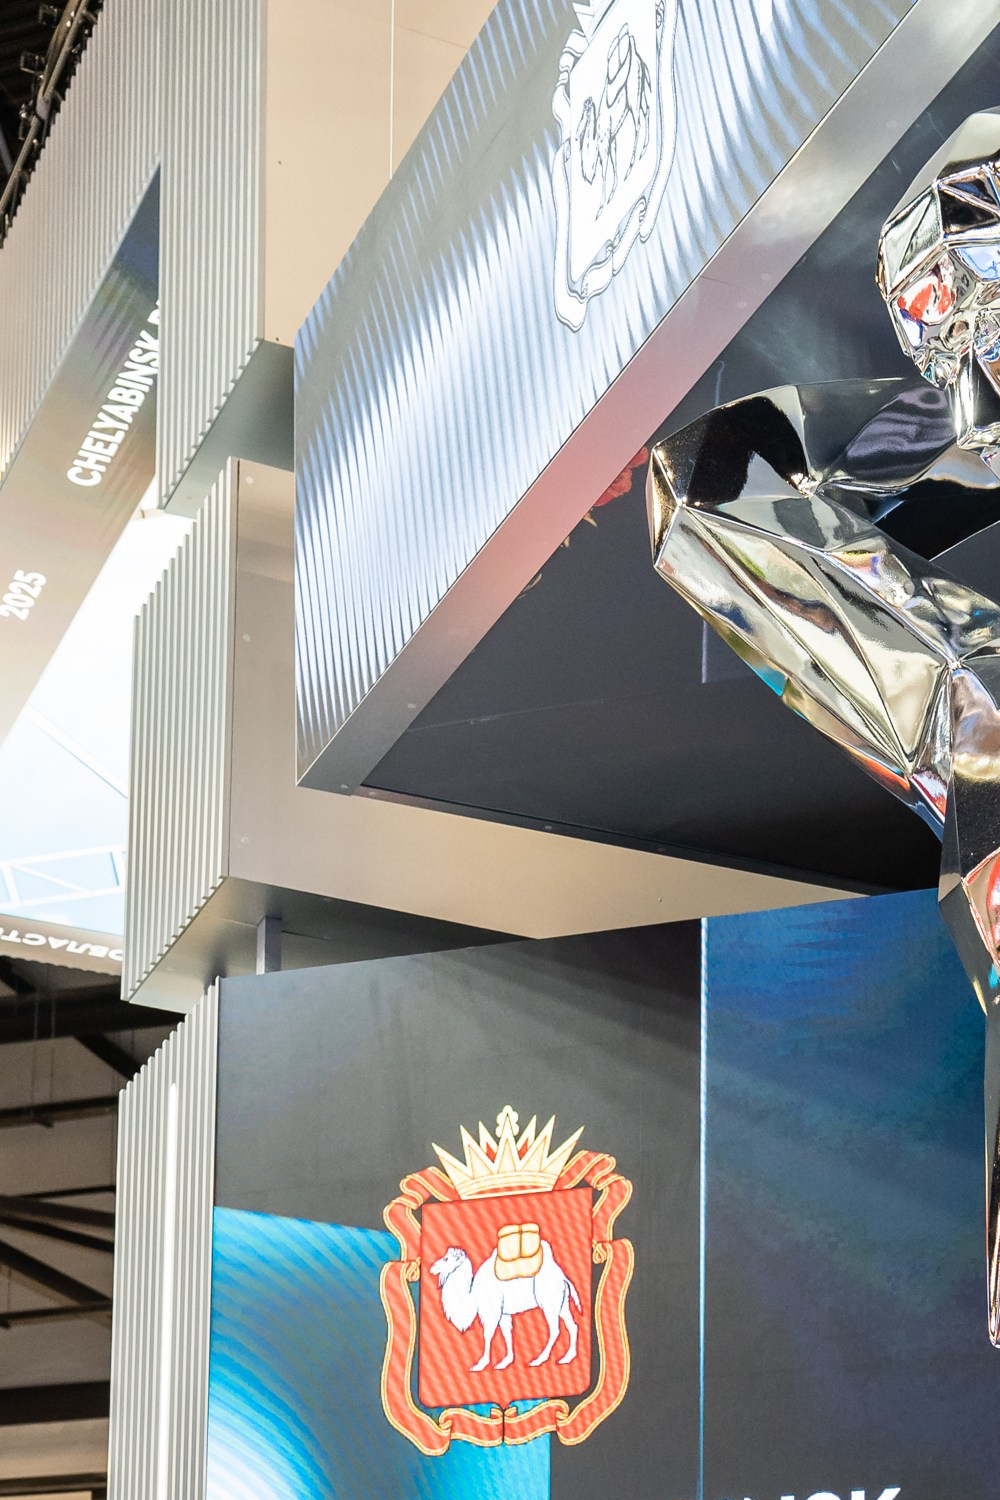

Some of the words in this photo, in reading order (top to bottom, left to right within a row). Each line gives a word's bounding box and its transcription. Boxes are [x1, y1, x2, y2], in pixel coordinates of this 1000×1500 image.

[66, 329, 160, 487] CHELYABINSK
[0, 568, 47, 622] 2025
[0, 926, 123, 962] ОБЛАСТ
